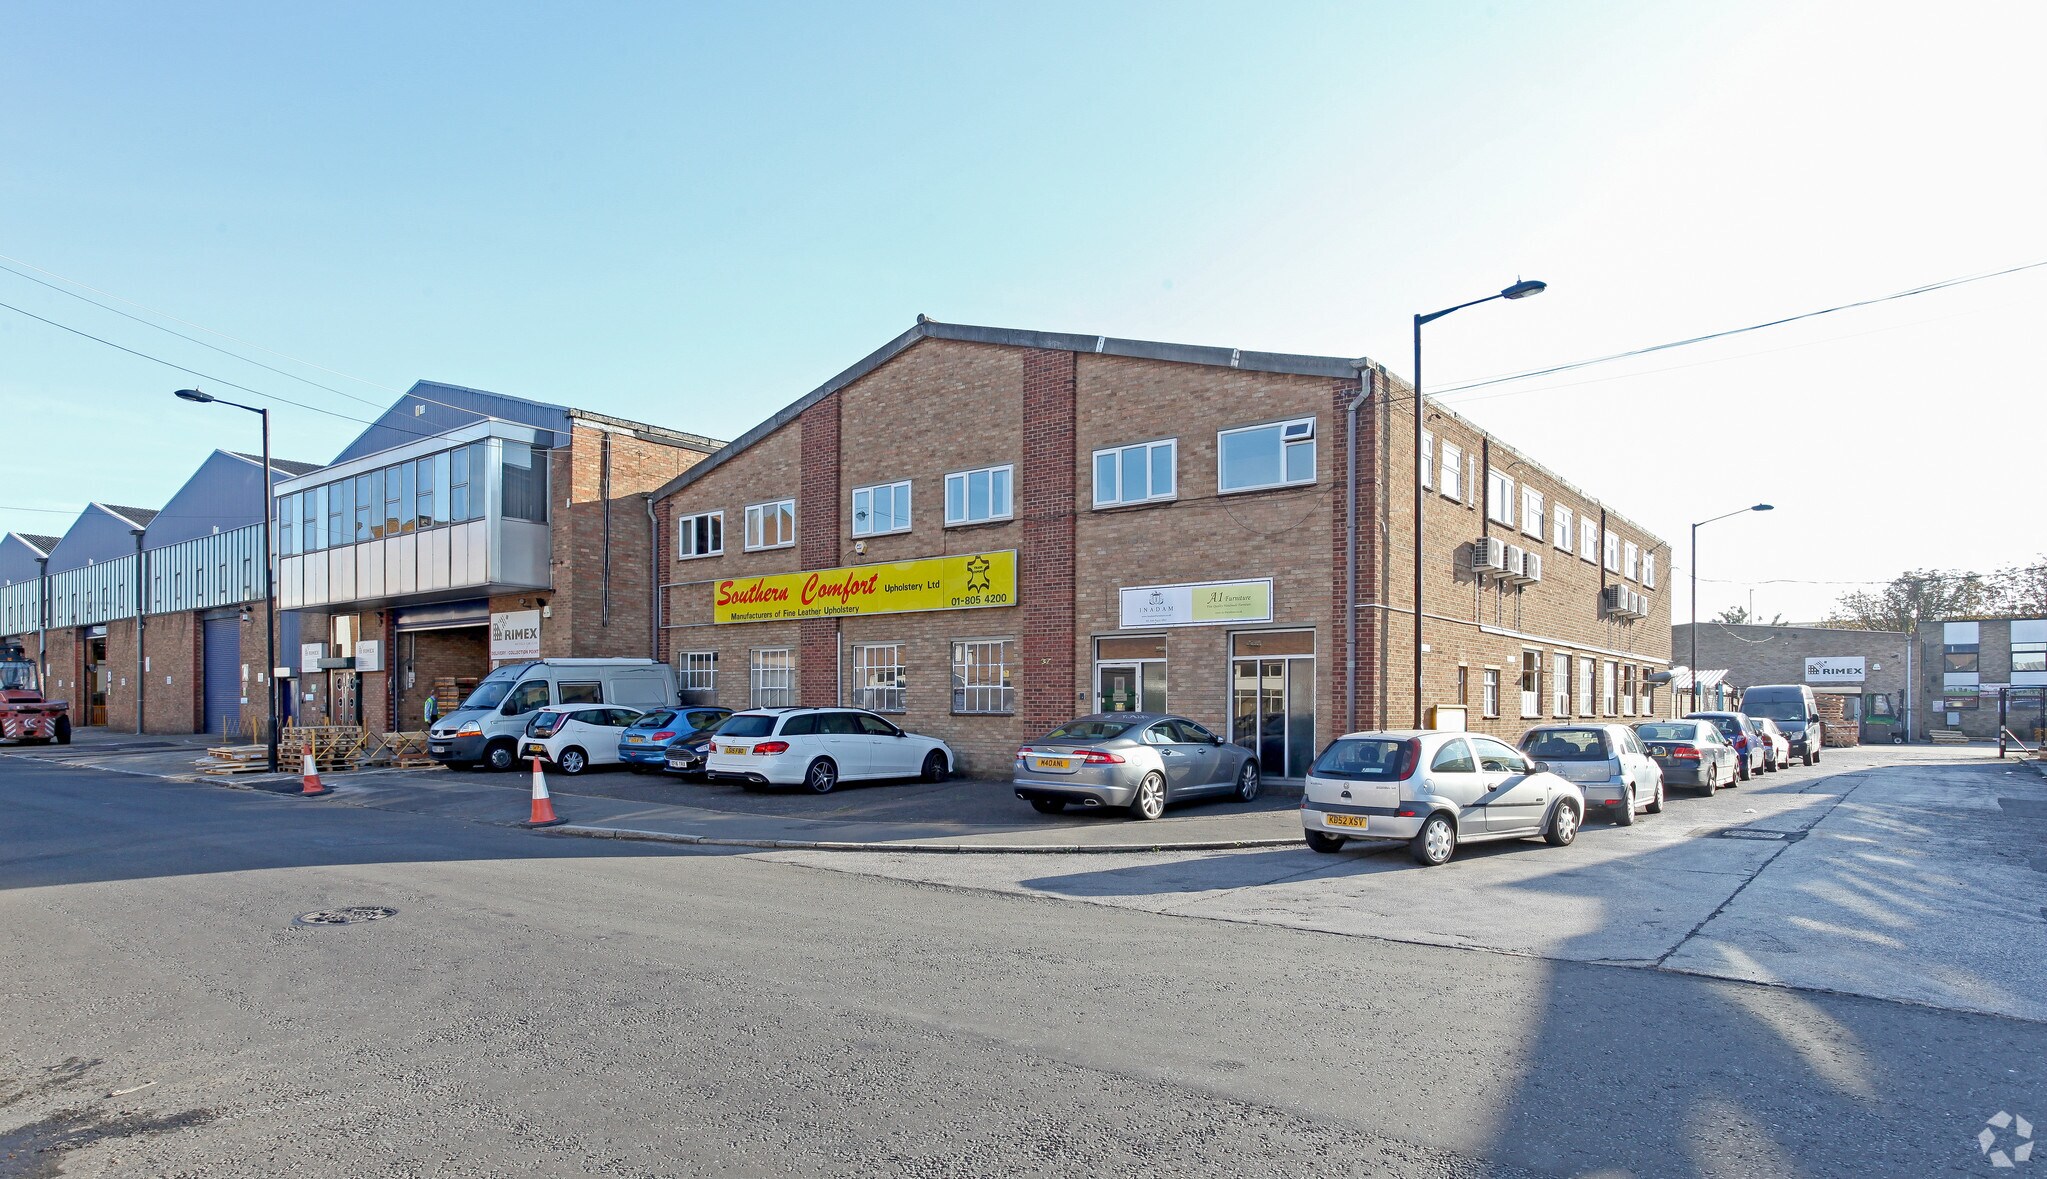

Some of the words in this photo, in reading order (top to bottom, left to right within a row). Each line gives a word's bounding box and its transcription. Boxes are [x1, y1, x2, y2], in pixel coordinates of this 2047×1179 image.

[717, 578, 788, 606] Southern
[801, 571, 878, 605] Comfort
[884, 583, 923, 593] Upholstery
[927, 580, 940, 589] Ltd
[951, 595, 981, 606] 01-805
[984, 593, 1007, 603] 4200
[1207, 591, 1224, 605] A1
[731, 612, 772, 620] Manufacturers
[783, 609, 795, 617] Fine
[797, 608, 822, 616] Leather
[823, 605, 860, 615] Upholstery
[1139, 605, 1175, 613] INADAM
[504, 627, 538, 641] RIMEX
